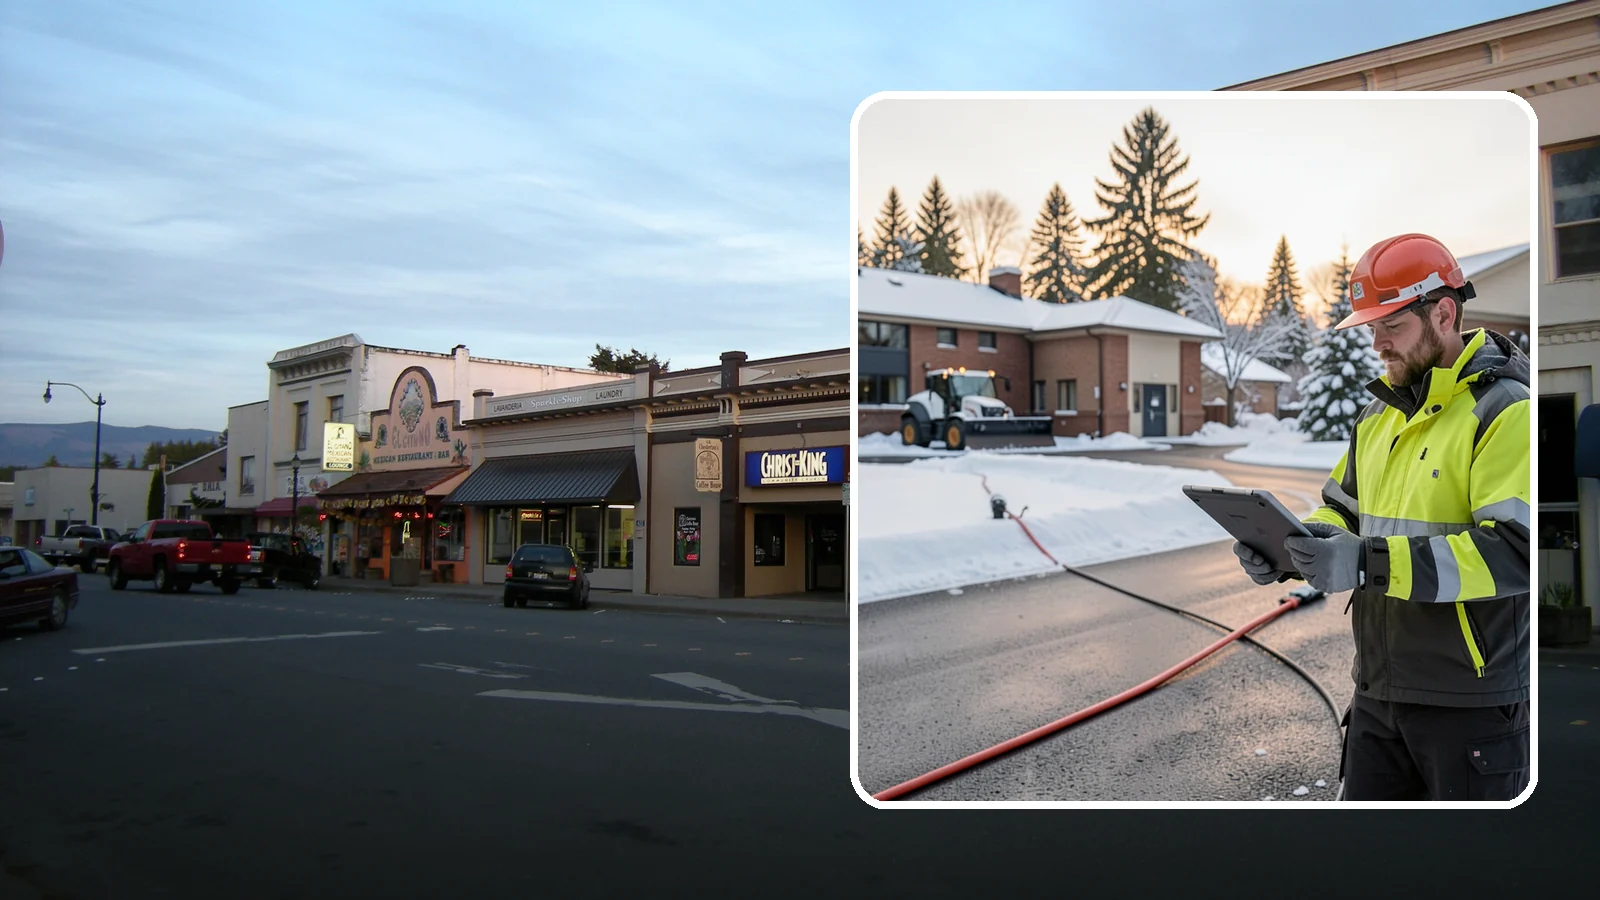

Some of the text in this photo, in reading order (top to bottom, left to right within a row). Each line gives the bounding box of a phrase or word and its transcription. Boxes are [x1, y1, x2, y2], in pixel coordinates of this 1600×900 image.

[561, 394, 582, 404] Shop
[595, 389, 624, 400] LAUNDRY
[493, 402, 523, 412] LAVANDERIA
[373, 454, 396, 464] MEXICAN
[398, 451, 433, 462] RESTAURANT
[437, 450, 450, 459] BAR
[760, 450, 827, 478] CHRIST KING
